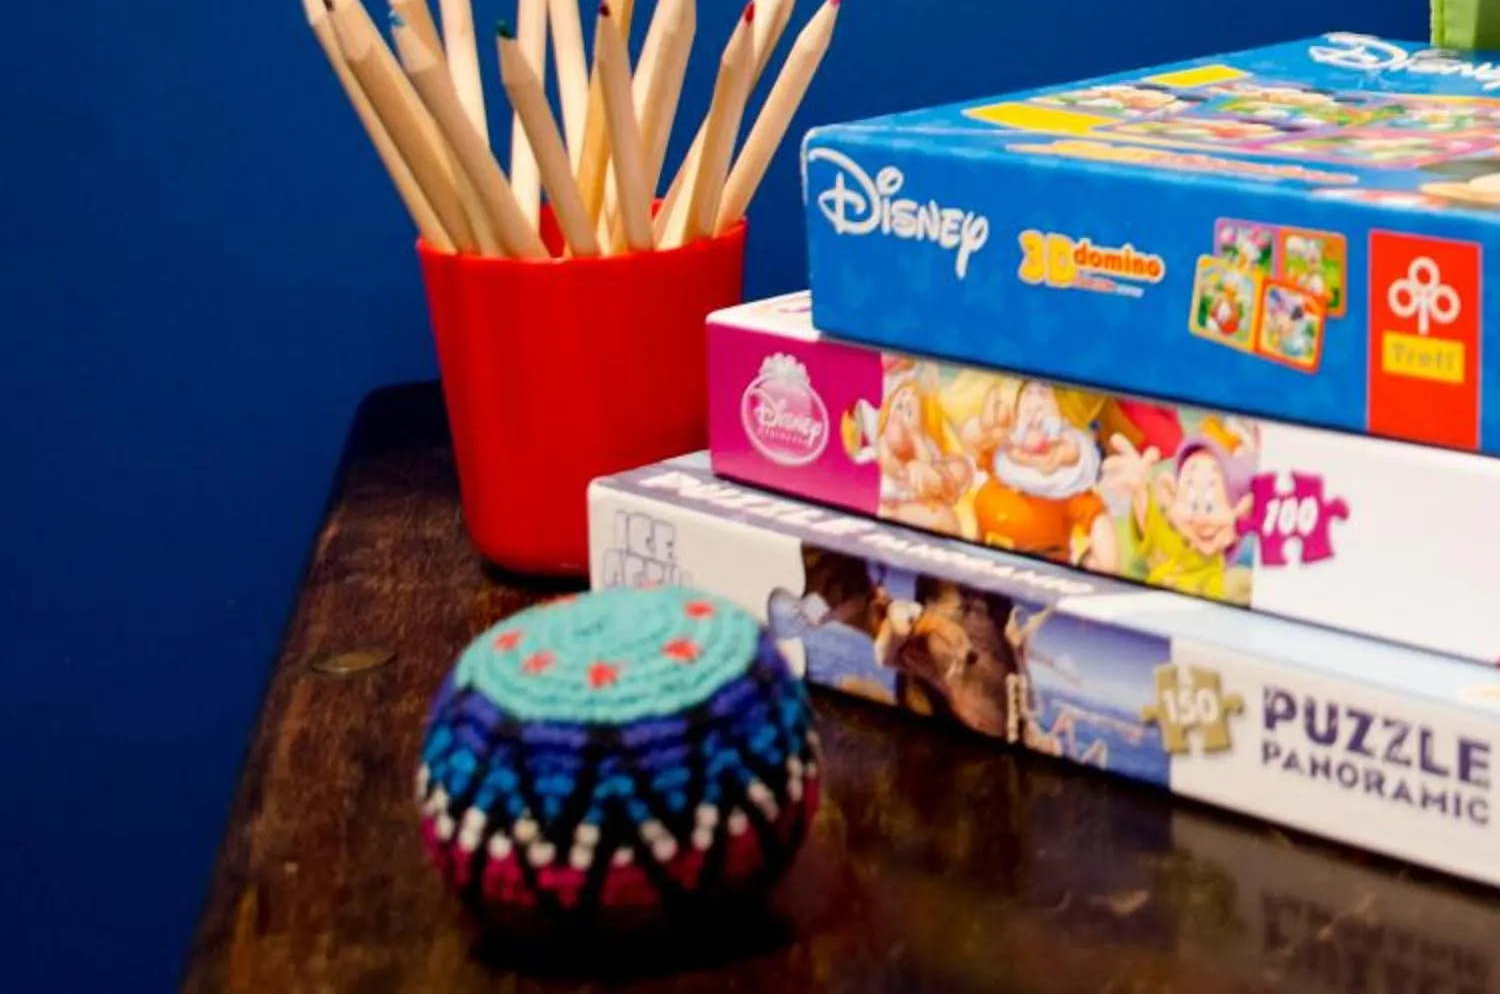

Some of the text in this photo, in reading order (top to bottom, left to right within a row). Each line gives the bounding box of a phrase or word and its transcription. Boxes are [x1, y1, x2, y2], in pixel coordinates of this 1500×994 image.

[1018, 228, 1077, 287] 3D
[1072, 237, 1165, 283] domino
[1262, 495, 1319, 537] 100
[1161, 688, 1219, 726] 150
[1263, 686, 1492, 790] PUZZLE
[1261, 738, 1490, 825] PANORAMIC
